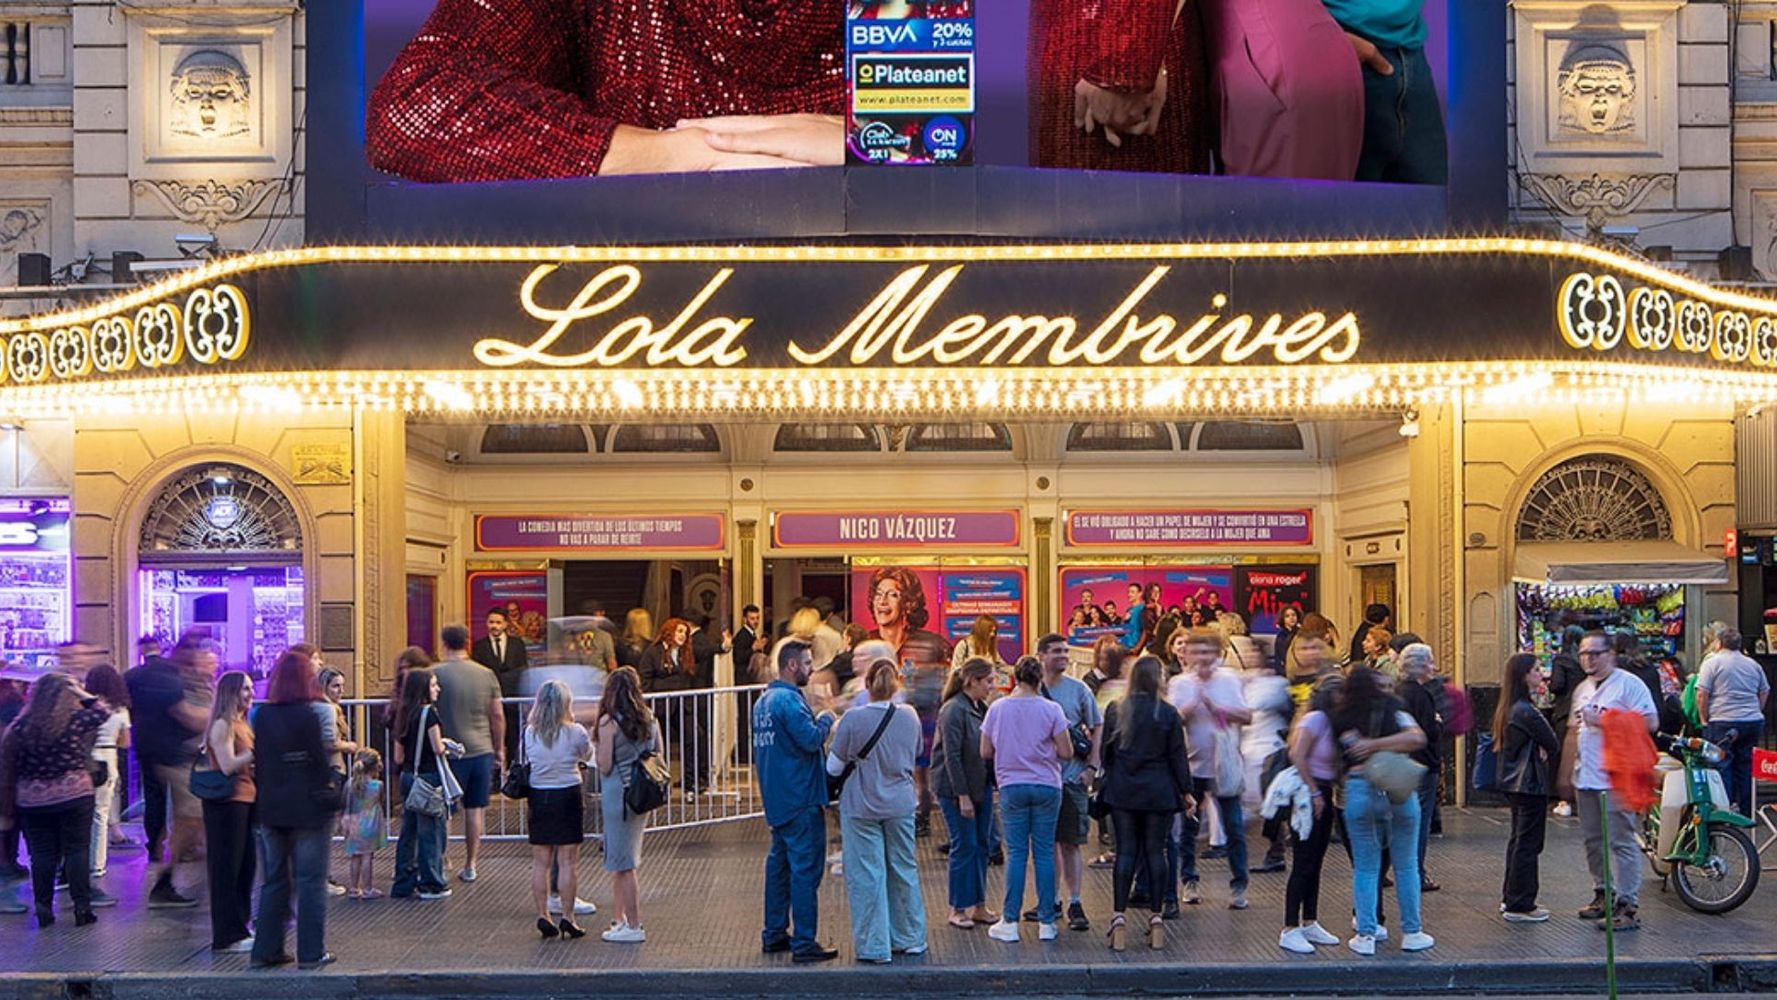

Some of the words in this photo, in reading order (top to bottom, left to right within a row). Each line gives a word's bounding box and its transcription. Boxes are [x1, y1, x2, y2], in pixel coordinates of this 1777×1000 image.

[853, 25, 917, 44] BBVA
[932, 23, 973, 38] 20%
[875, 64, 966, 83] Plateanet
[859, 94, 967, 105] www.plateanet.com
[931, 128, 957, 142] ON
[473, 263, 753, 368] Lola
[789, 262, 1360, 367] Membrives
[839, 517, 879, 539] NICO
[885, 514, 956, 542] VÁZQUEZ
[1275, 576, 1302, 586] roger
